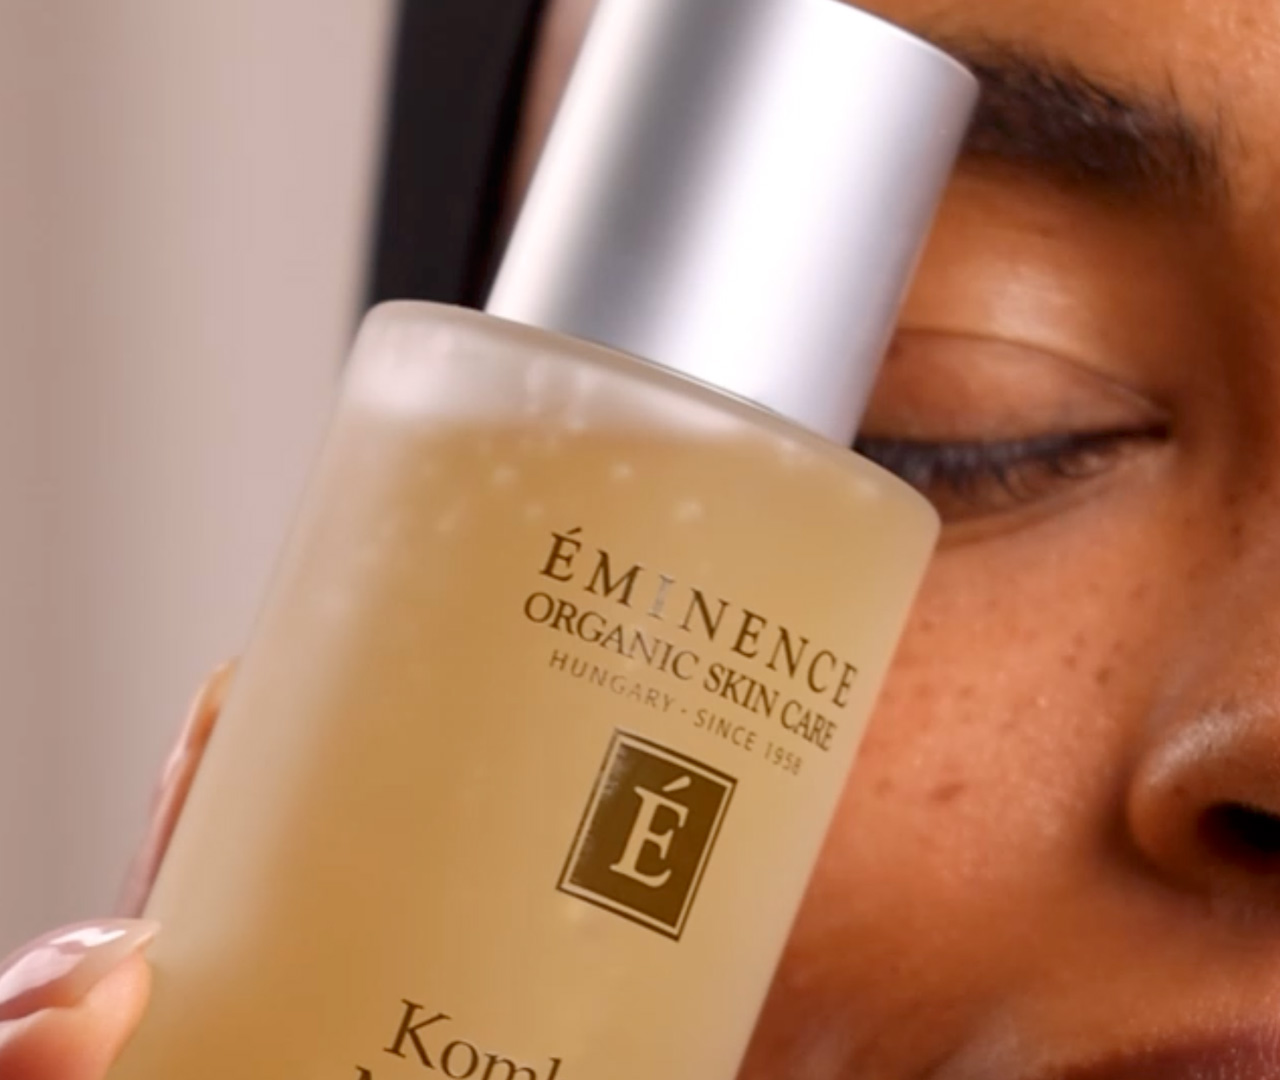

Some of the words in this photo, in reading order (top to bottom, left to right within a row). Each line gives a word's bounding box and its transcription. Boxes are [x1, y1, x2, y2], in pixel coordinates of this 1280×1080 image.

[523, 591, 700, 682] ORGANIC
[703, 662, 780, 718] SKIN
[780, 699, 837, 752] CARE
[538, 526, 859, 709] ÉMINENCE
[549, 649, 675, 713] HUNGARY
[694, 708, 757, 752] SINCE
[764, 741, 804, 776] 1958
[609, 775, 692, 887] É
